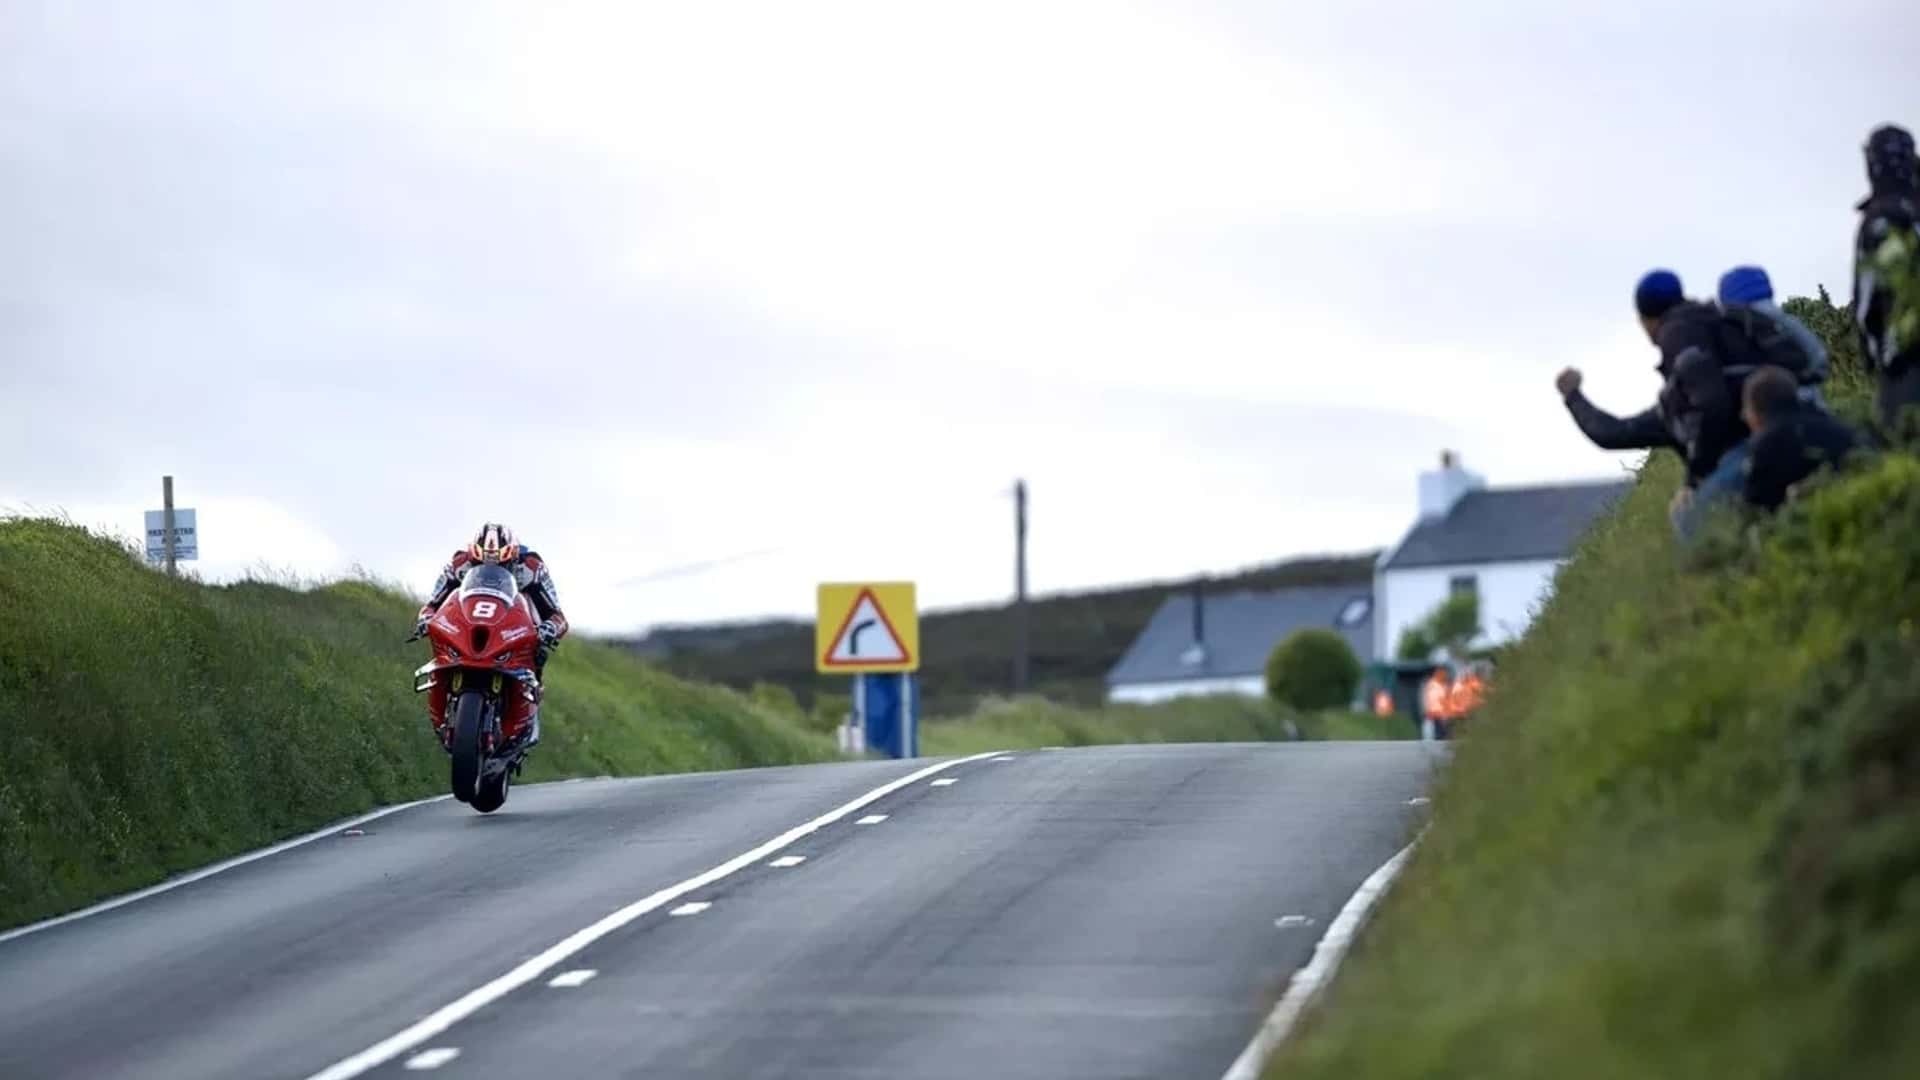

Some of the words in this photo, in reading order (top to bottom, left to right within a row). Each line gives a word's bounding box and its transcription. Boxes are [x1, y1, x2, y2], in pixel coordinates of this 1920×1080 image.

[148, 528, 194, 536] RESTCTED
[161, 536, 182, 544] AA
[472, 601, 497, 618] 8
